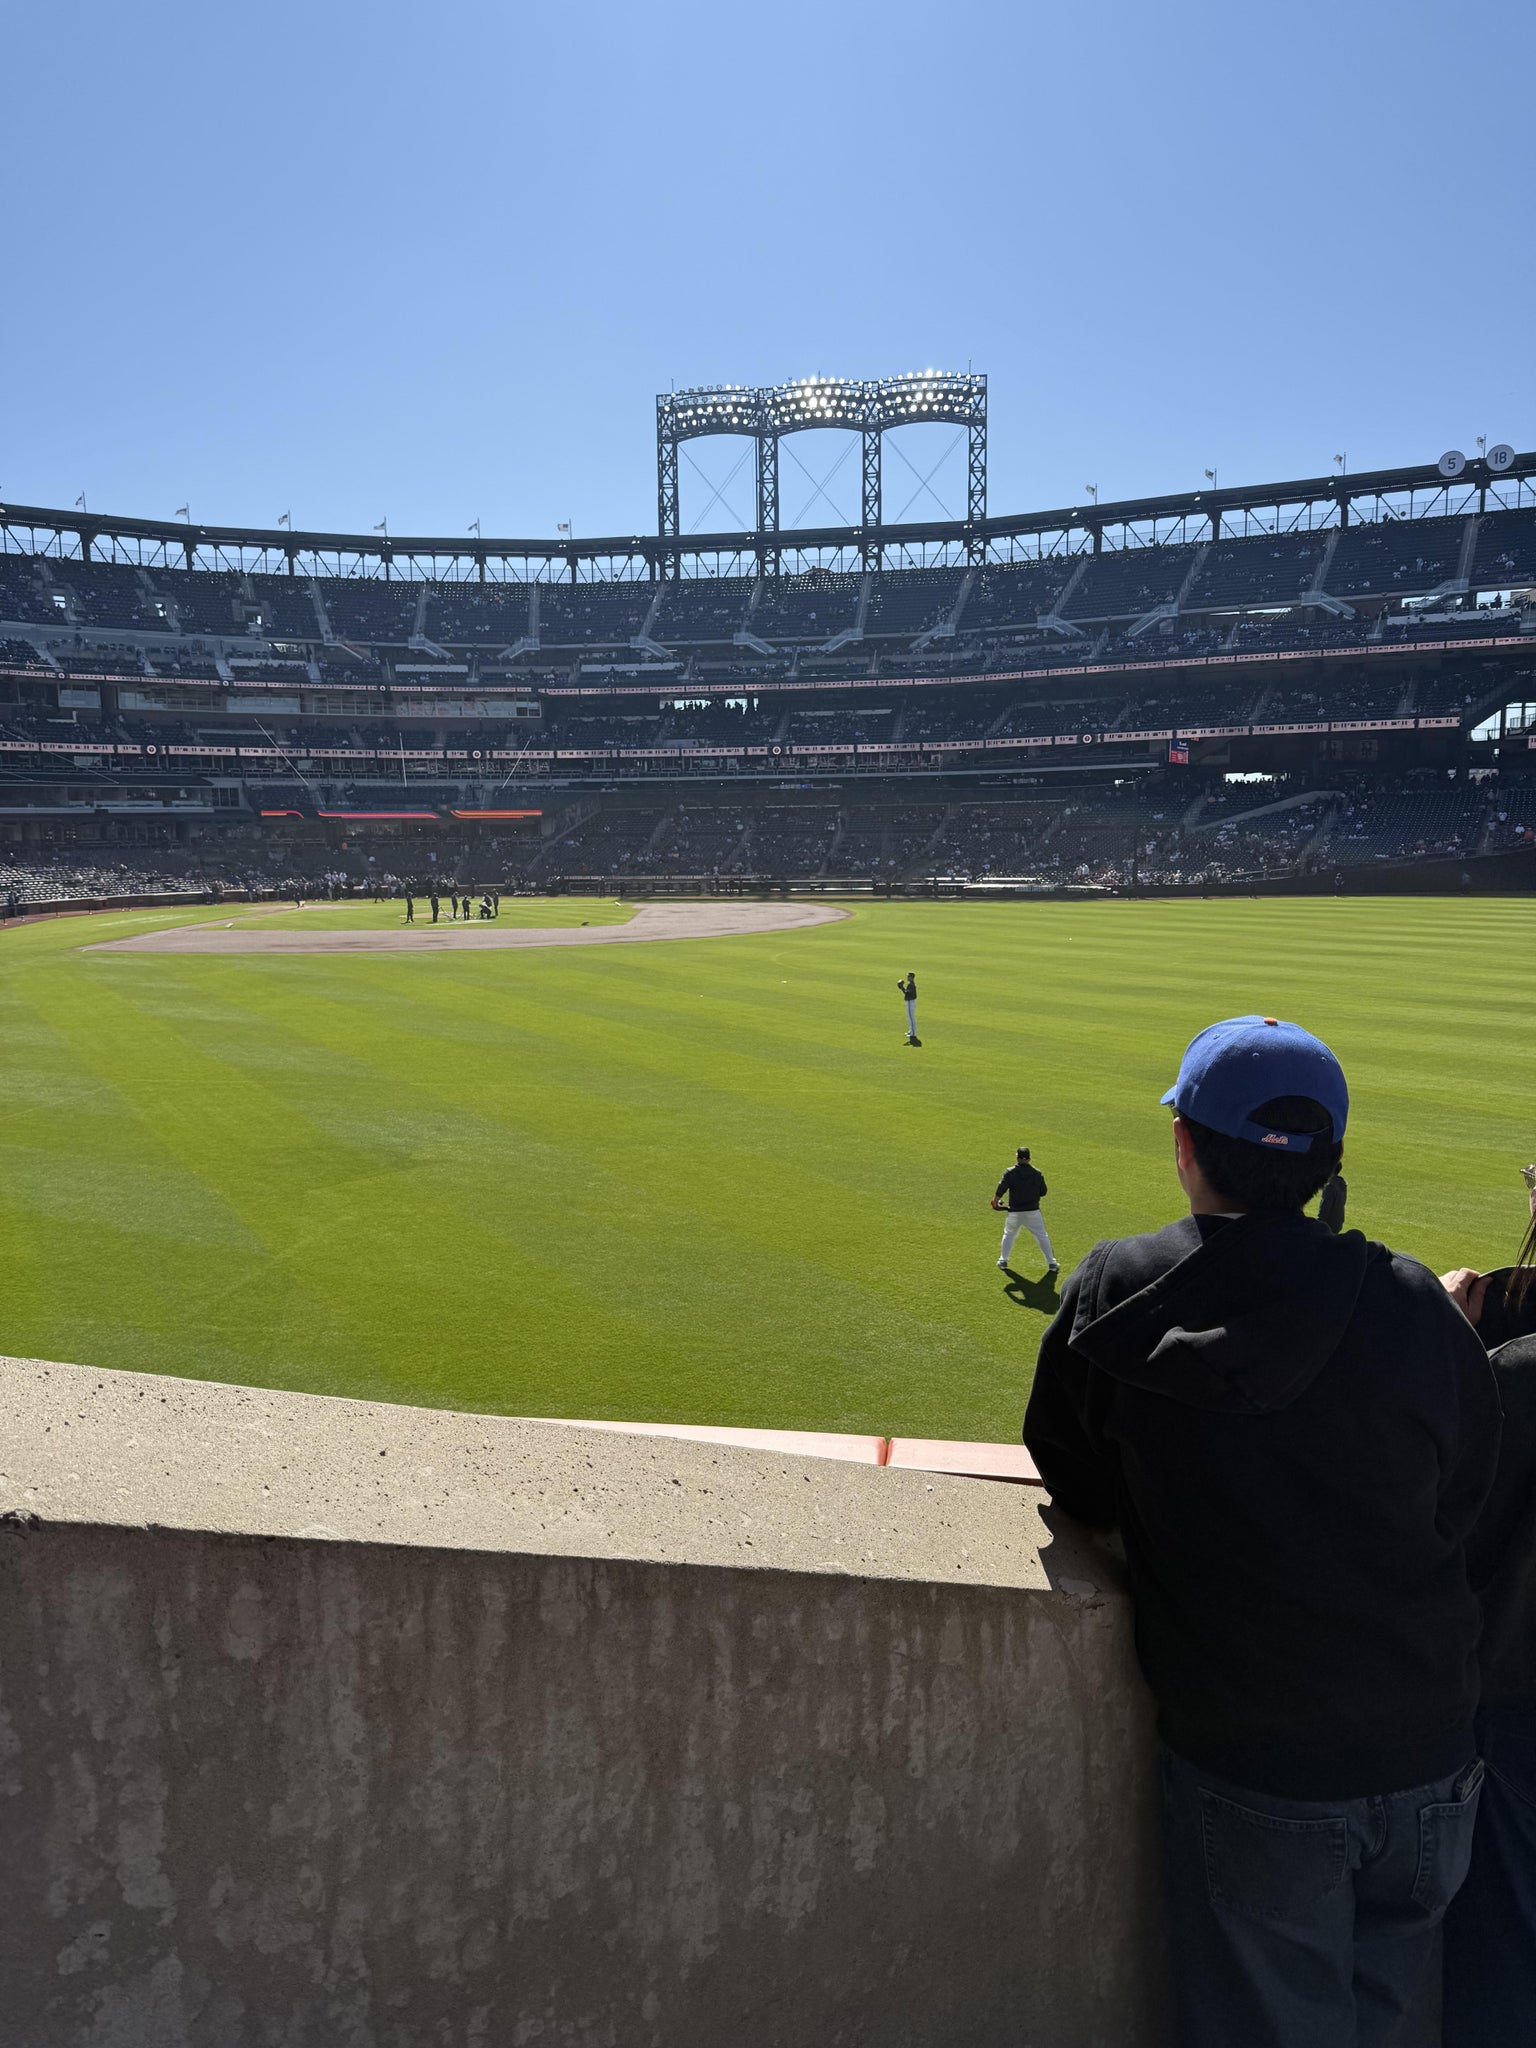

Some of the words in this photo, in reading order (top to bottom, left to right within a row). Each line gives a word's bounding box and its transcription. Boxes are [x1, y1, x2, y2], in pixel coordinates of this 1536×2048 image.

[1448, 457, 1456, 470] 5
[1494, 451, 1507, 465] 18
[1261, 1133, 1289, 1145] Mets
